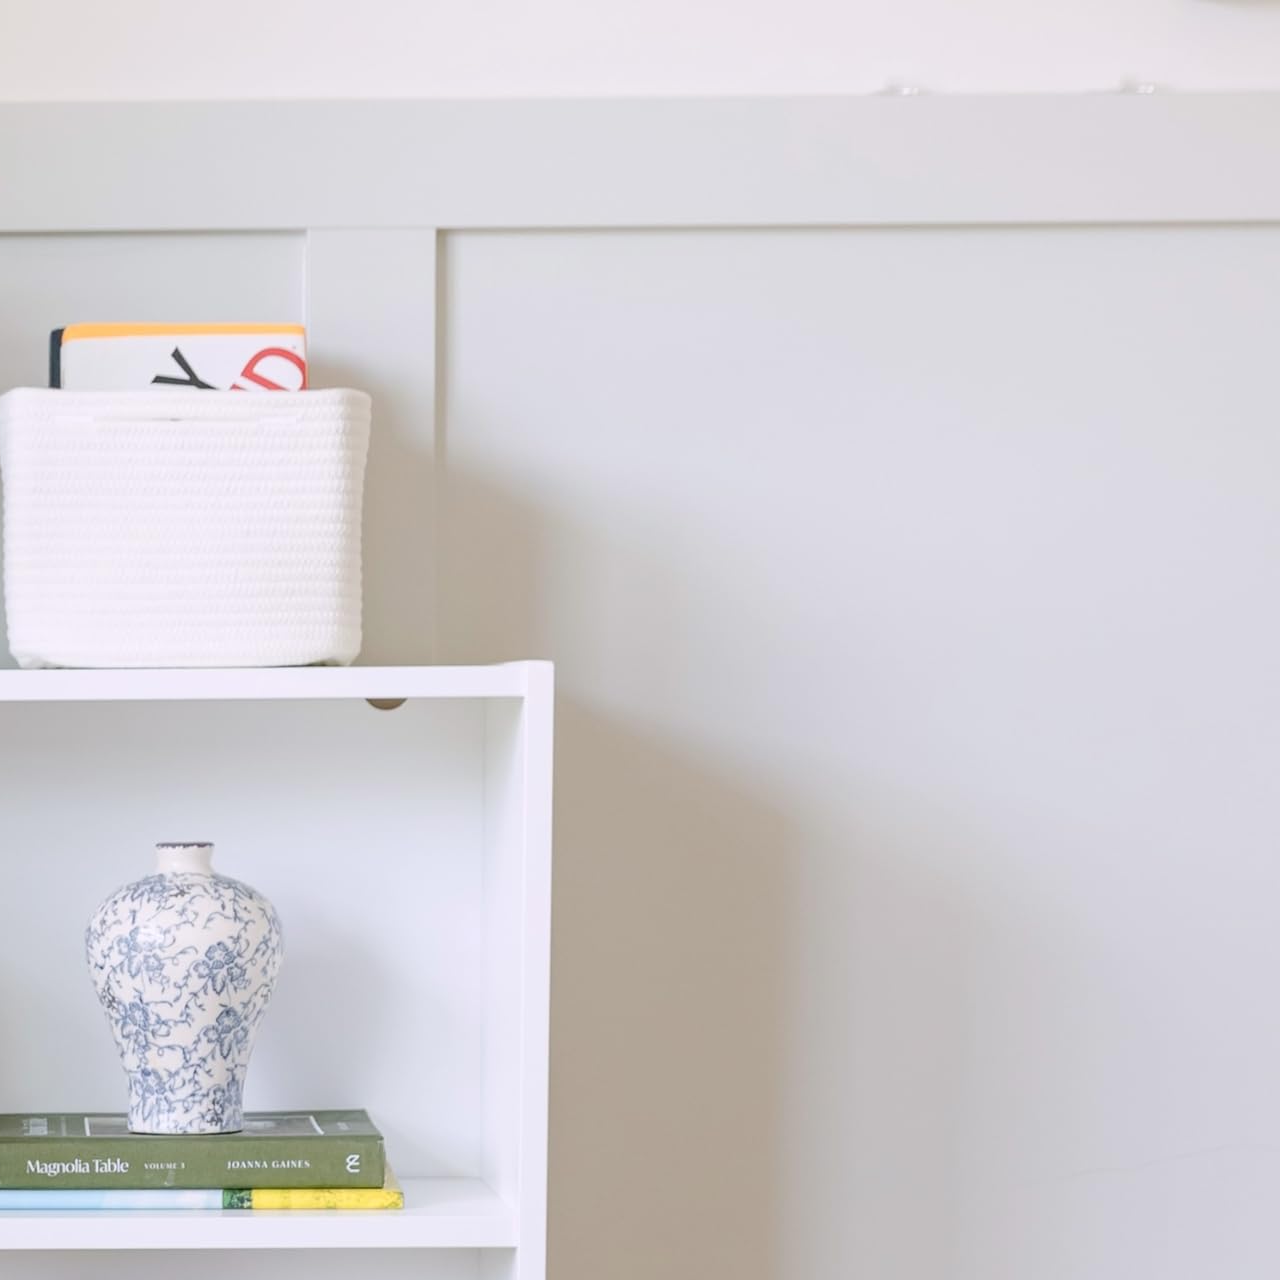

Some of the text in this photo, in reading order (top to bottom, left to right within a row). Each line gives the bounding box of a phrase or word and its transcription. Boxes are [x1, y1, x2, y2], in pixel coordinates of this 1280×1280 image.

[26, 1158, 90, 1177] Magnolia
[92, 1158, 130, 1174] Table
[143, 1161, 177, 1170] VOLUME
[227, 1160, 269, 1170] JOANNA
[271, 1159, 311, 1170] GAINES
